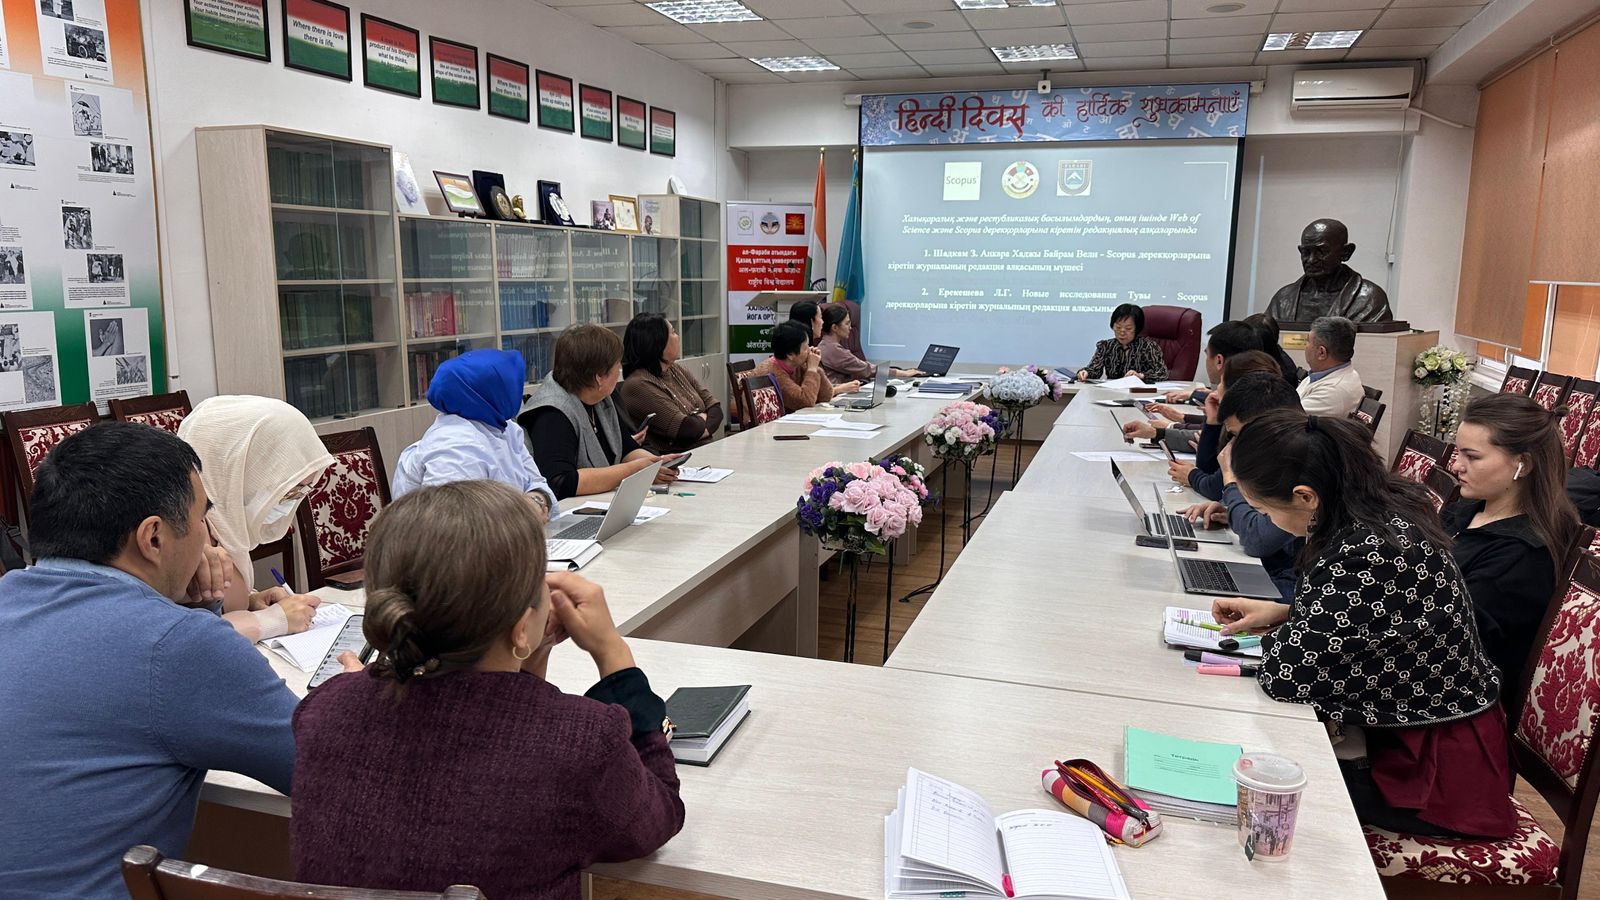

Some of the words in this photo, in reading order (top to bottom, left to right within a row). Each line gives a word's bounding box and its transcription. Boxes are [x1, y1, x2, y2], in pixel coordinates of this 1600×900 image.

[293, 20, 311, 31] Where
[312, 26, 326, 35] there
[333, 31, 344, 40] love
[304, 33, 318, 43] there
[369, 42, 386, 50] product
[894, 95, 956, 133] हिन्दी
[958, 95, 1030, 138] दिवस
[1040, 94, 1066, 117] की
[946, 176, 977, 186] Scopus
[902, 214, 954, 224] Халықаралық
[979, 214, 1039, 224] республикалық
[1114, 216, 1136, 224] оның
[1138, 214, 1168, 222] ішінде
[1170, 213, 1187, 222] Web
[1190, 213, 1201, 224] of
[902, 226, 930, 234] Science
[955, 226, 981, 236] Scopus
[1050, 226, 1081, 235] кіретін
[1082, 226, 1138, 235] редакциялық
[1140, 226, 1197, 235] алқаларында
[924, 249, 931, 257] 1.
[980, 250, 1010, 259] Анкара
[1044, 250, 1074, 259] Байрам
[1077, 250, 1098, 258] Вели
[1107, 250, 1136, 260] Scopus
[888, 262, 914, 271] кіретін
[916, 263, 966, 272] журналының
[968, 264, 1004, 272] редакция
[1053, 263, 1083, 273] мүшесі
[922, 288, 928, 296] 2.
[939, 288, 984, 298] Ерекешева
[994, 288, 1012, 297] Л.Г.
[1128, 291, 1151, 300] Тувы
[1177, 292, 1208, 302] Scopus
[949, 301, 976, 311] кіретін
[978, 302, 1031, 312] журналының
[1032, 304, 1070, 312] редакция
